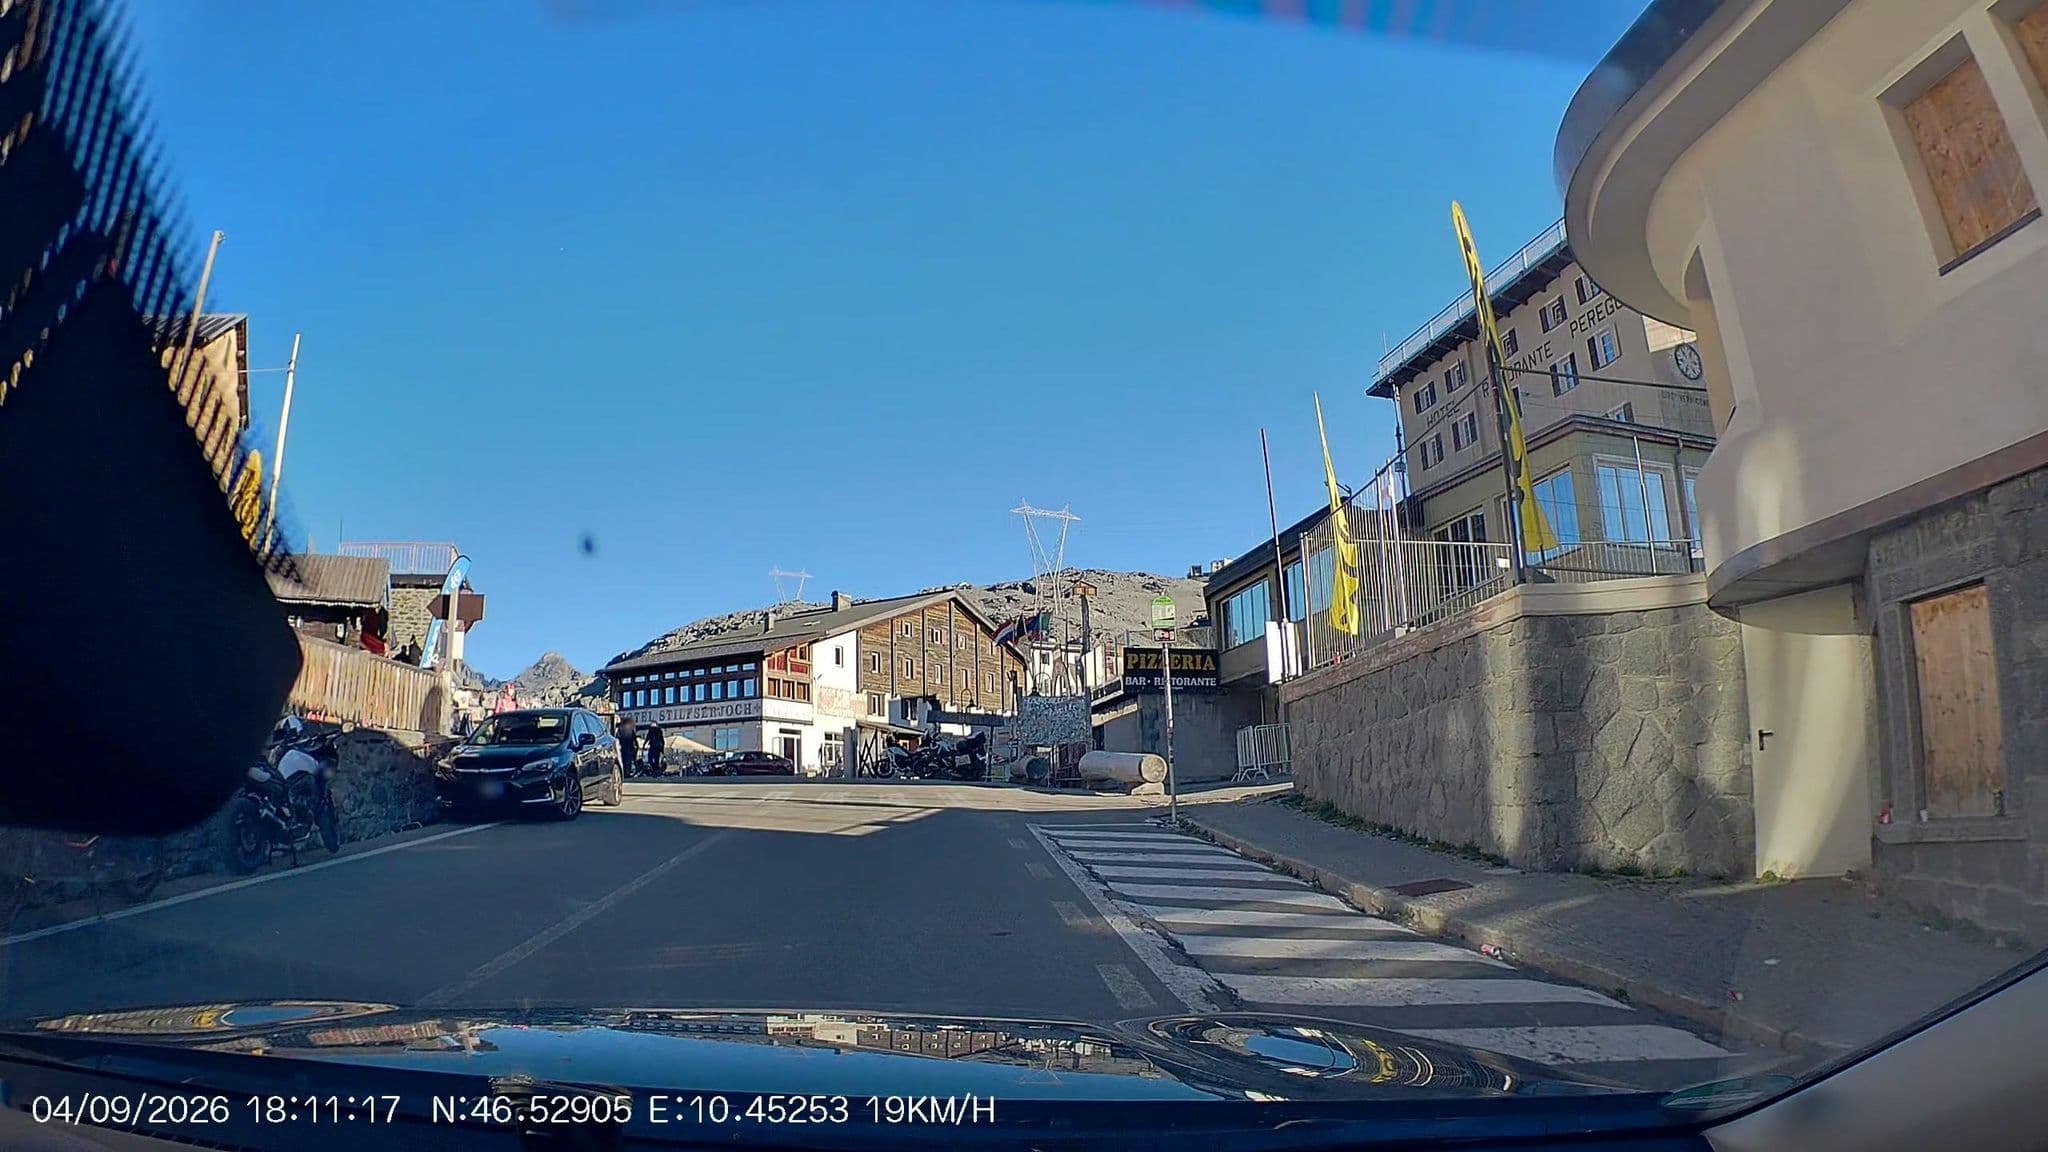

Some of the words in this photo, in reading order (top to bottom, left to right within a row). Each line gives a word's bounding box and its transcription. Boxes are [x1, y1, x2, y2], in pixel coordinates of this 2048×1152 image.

[1425, 401, 1460, 427] HOTEL
[1481, 341, 1553, 398] RRANTE
[1125, 676, 1146, 686] BAR
[1154, 677, 1216, 686] RITORANTE
[660, 703, 752, 721] STILFSERJOCH
